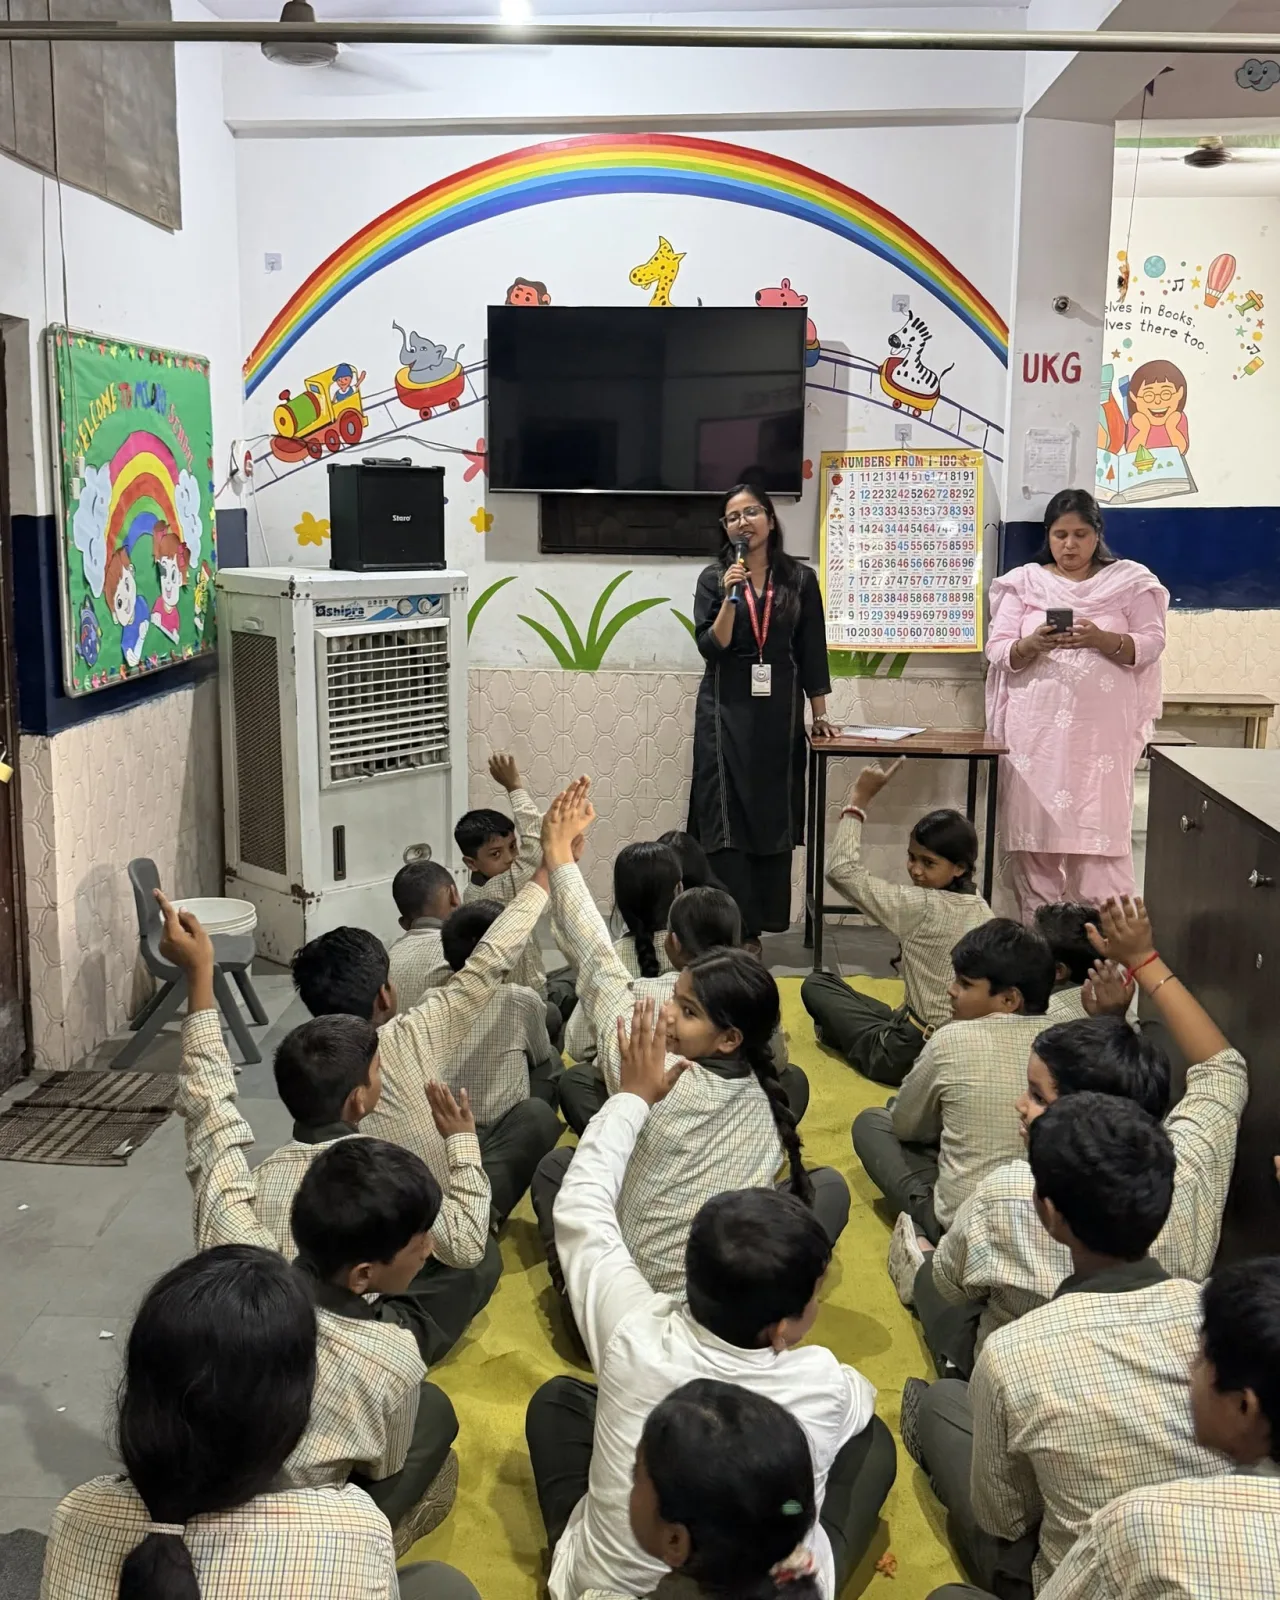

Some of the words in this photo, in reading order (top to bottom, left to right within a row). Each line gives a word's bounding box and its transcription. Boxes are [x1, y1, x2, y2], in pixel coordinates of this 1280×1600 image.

[1140, 302, 1152, 314] in
[1158, 304, 1196, 328] Books,
[1140, 319, 1178, 338] there
[1184, 331, 1208, 354] too.
[1022, 351, 1082, 384] UKG
[118, 382, 132, 410] TO
[840, 455, 891, 468] NUMBERS
[895, 455, 924, 467] FROM
[850, 473, 854, 481] 1
[860, 473, 870, 481] 11
[873, 473, 883, 481] 21
[886, 473, 896, 481] 31
[899, 473, 909, 481] 41
[912, 472, 922, 480] 51
[937, 472, 948, 480] 71
[951, 472, 961, 480] 81
[963, 472, 974, 480] 91
[860, 490, 870, 498] 12
[872, 490, 884, 498] 22
[885, 490, 897, 498] 32
[898, 490, 910, 498] 42
[911, 490, 923, 498] 52
[924, 490, 935, 498] 62
[937, 490, 948, 498] 72
[950, 490, 961, 498] 82
[962, 489, 974, 497] 92
[849, 507, 855, 515] 3
[860, 507, 870, 515] 13
[872, 507, 884, 515] 23
[885, 507, 896, 515] 33
[898, 507, 909, 515] 43
[911, 507, 922, 515] 53
[924, 506, 935, 514] 63
[937, 506, 948, 514] 73
[950, 506, 961, 514] 83
[962, 506, 974, 514] 93
[849, 525, 855, 533] 4
[859, 525, 870, 533] 14
[872, 525, 883, 533] 24
[885, 525, 896, 533] 34
[898, 524, 909, 533] 44
[911, 524, 922, 532] 54
[924, 524, 935, 532] 64
[962, 524, 974, 532] 94
[849, 542, 854, 550] 5
[859, 542, 870, 550] 15
[885, 542, 896, 550] 35
[898, 542, 909, 550] 45
[911, 542, 922, 550] 55
[924, 541, 935, 550] 65
[937, 541, 948, 549] 75
[949, 541, 961, 549] 85
[962, 541, 974, 549] 95
[859, 560, 870, 568] 16
[897, 559, 909, 567] 46
[911, 559, 922, 567] 56
[923, 559, 935, 567] 66
[936, 559, 948, 567] 76
[949, 559, 961, 567] 86
[962, 559, 974, 567] 96
[848, 577, 854, 585] 7
[859, 577, 870, 585] 17
[871, 577, 882, 585] 27
[885, 577, 896, 585] 37
[897, 577, 909, 585] 47
[910, 577, 922, 585] 57
[923, 577, 934, 585] 67
[936, 576, 948, 584] 77
[949, 576, 961, 584] 87
[962, 576, 973, 584] 97
[849, 594, 854, 602] 8
[859, 594, 870, 602] 18
[871, 594, 883, 602] 28
[884, 594, 896, 602] 38
[897, 594, 908, 602] 48
[910, 594, 922, 602] 58
[923, 594, 934, 602] 68
[949, 593, 960, 601] 88
[962, 593, 974, 601] 98
[848, 611, 854, 619] 9
[859, 611, 870, 619] 19
[872, 611, 883, 619] 29
[884, 611, 896, 619] 39
[897, 611, 908, 619] 49
[910, 611, 922, 619] 59
[923, 611, 934, 619] 69
[936, 611, 948, 619] 79
[949, 610, 961, 619] 89
[962, 610, 974, 618] 99
[846, 628, 857, 636] 10
[858, 628, 870, 636] 20
[871, 628, 883, 636] 30
[884, 628, 896, 636] 40
[897, 628, 908, 636] 50
[910, 628, 922, 636] 60
[923, 628, 935, 636] 70
[936, 628, 947, 636] 80
[949, 628, 961, 636] 90
[962, 628, 974, 636] 100
